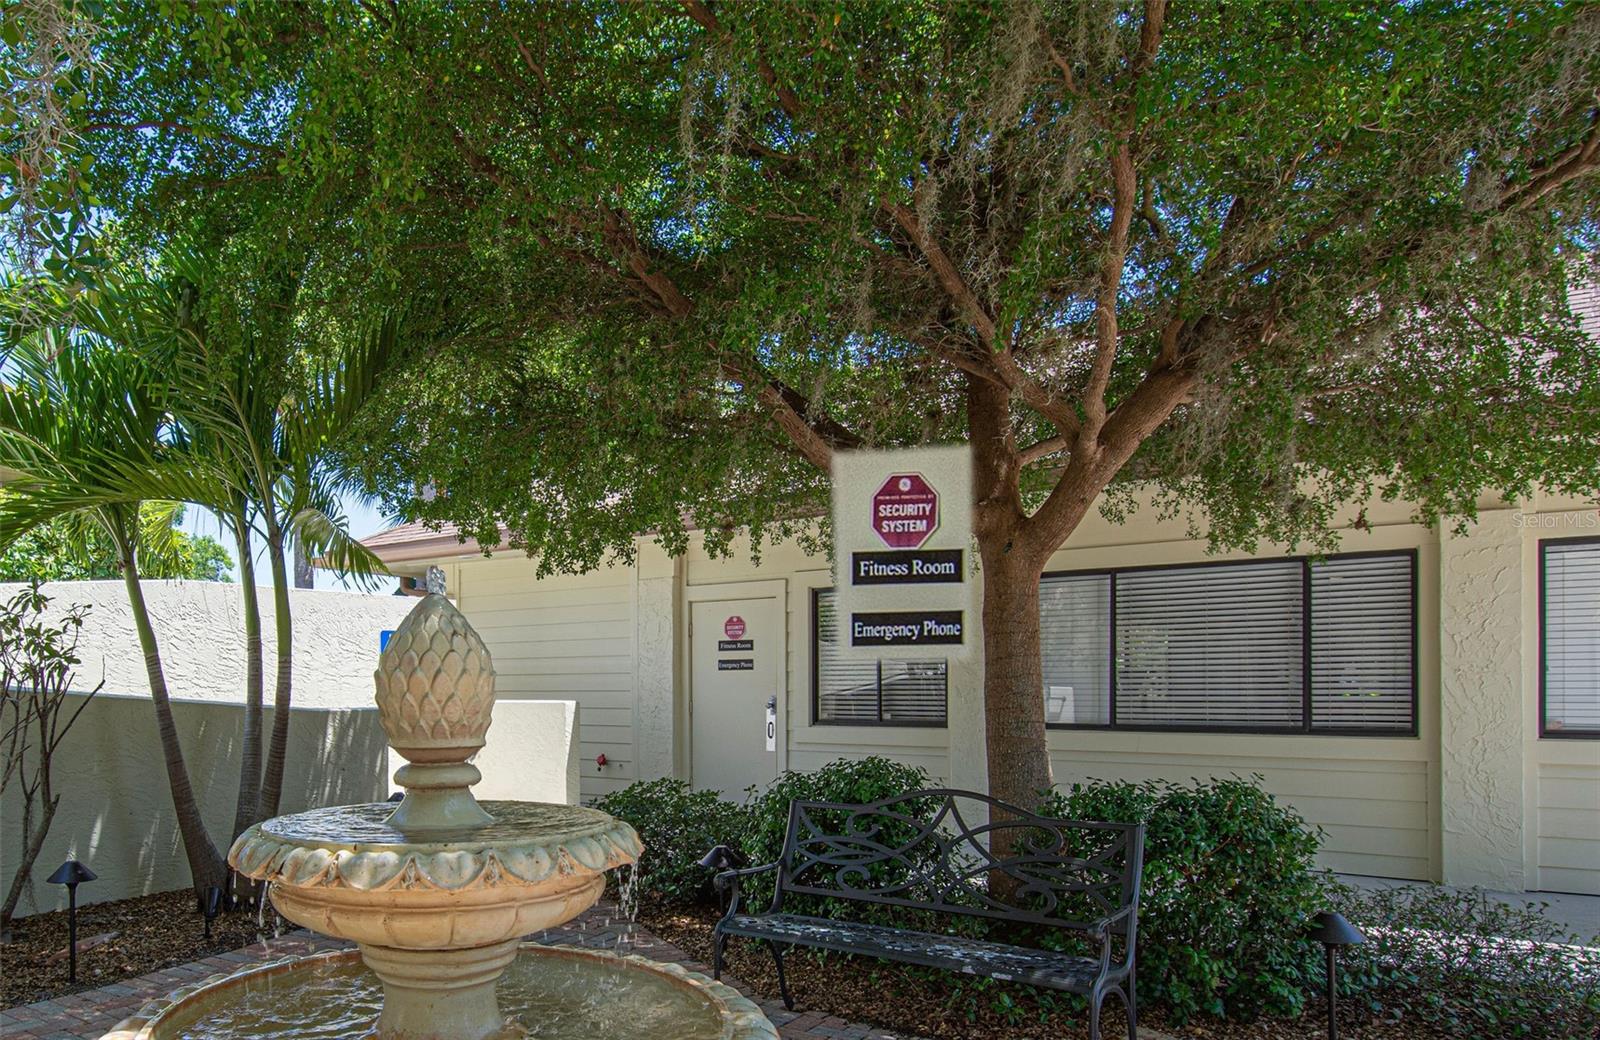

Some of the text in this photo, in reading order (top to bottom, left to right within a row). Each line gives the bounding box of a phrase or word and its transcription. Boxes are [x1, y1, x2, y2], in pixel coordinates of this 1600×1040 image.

[879, 503, 932, 517] SECURITY
[881, 520, 928, 533] SYSTEM
[860, 559, 955, 576] Fitness Room
[854, 620, 961, 640] Emergency Phone
